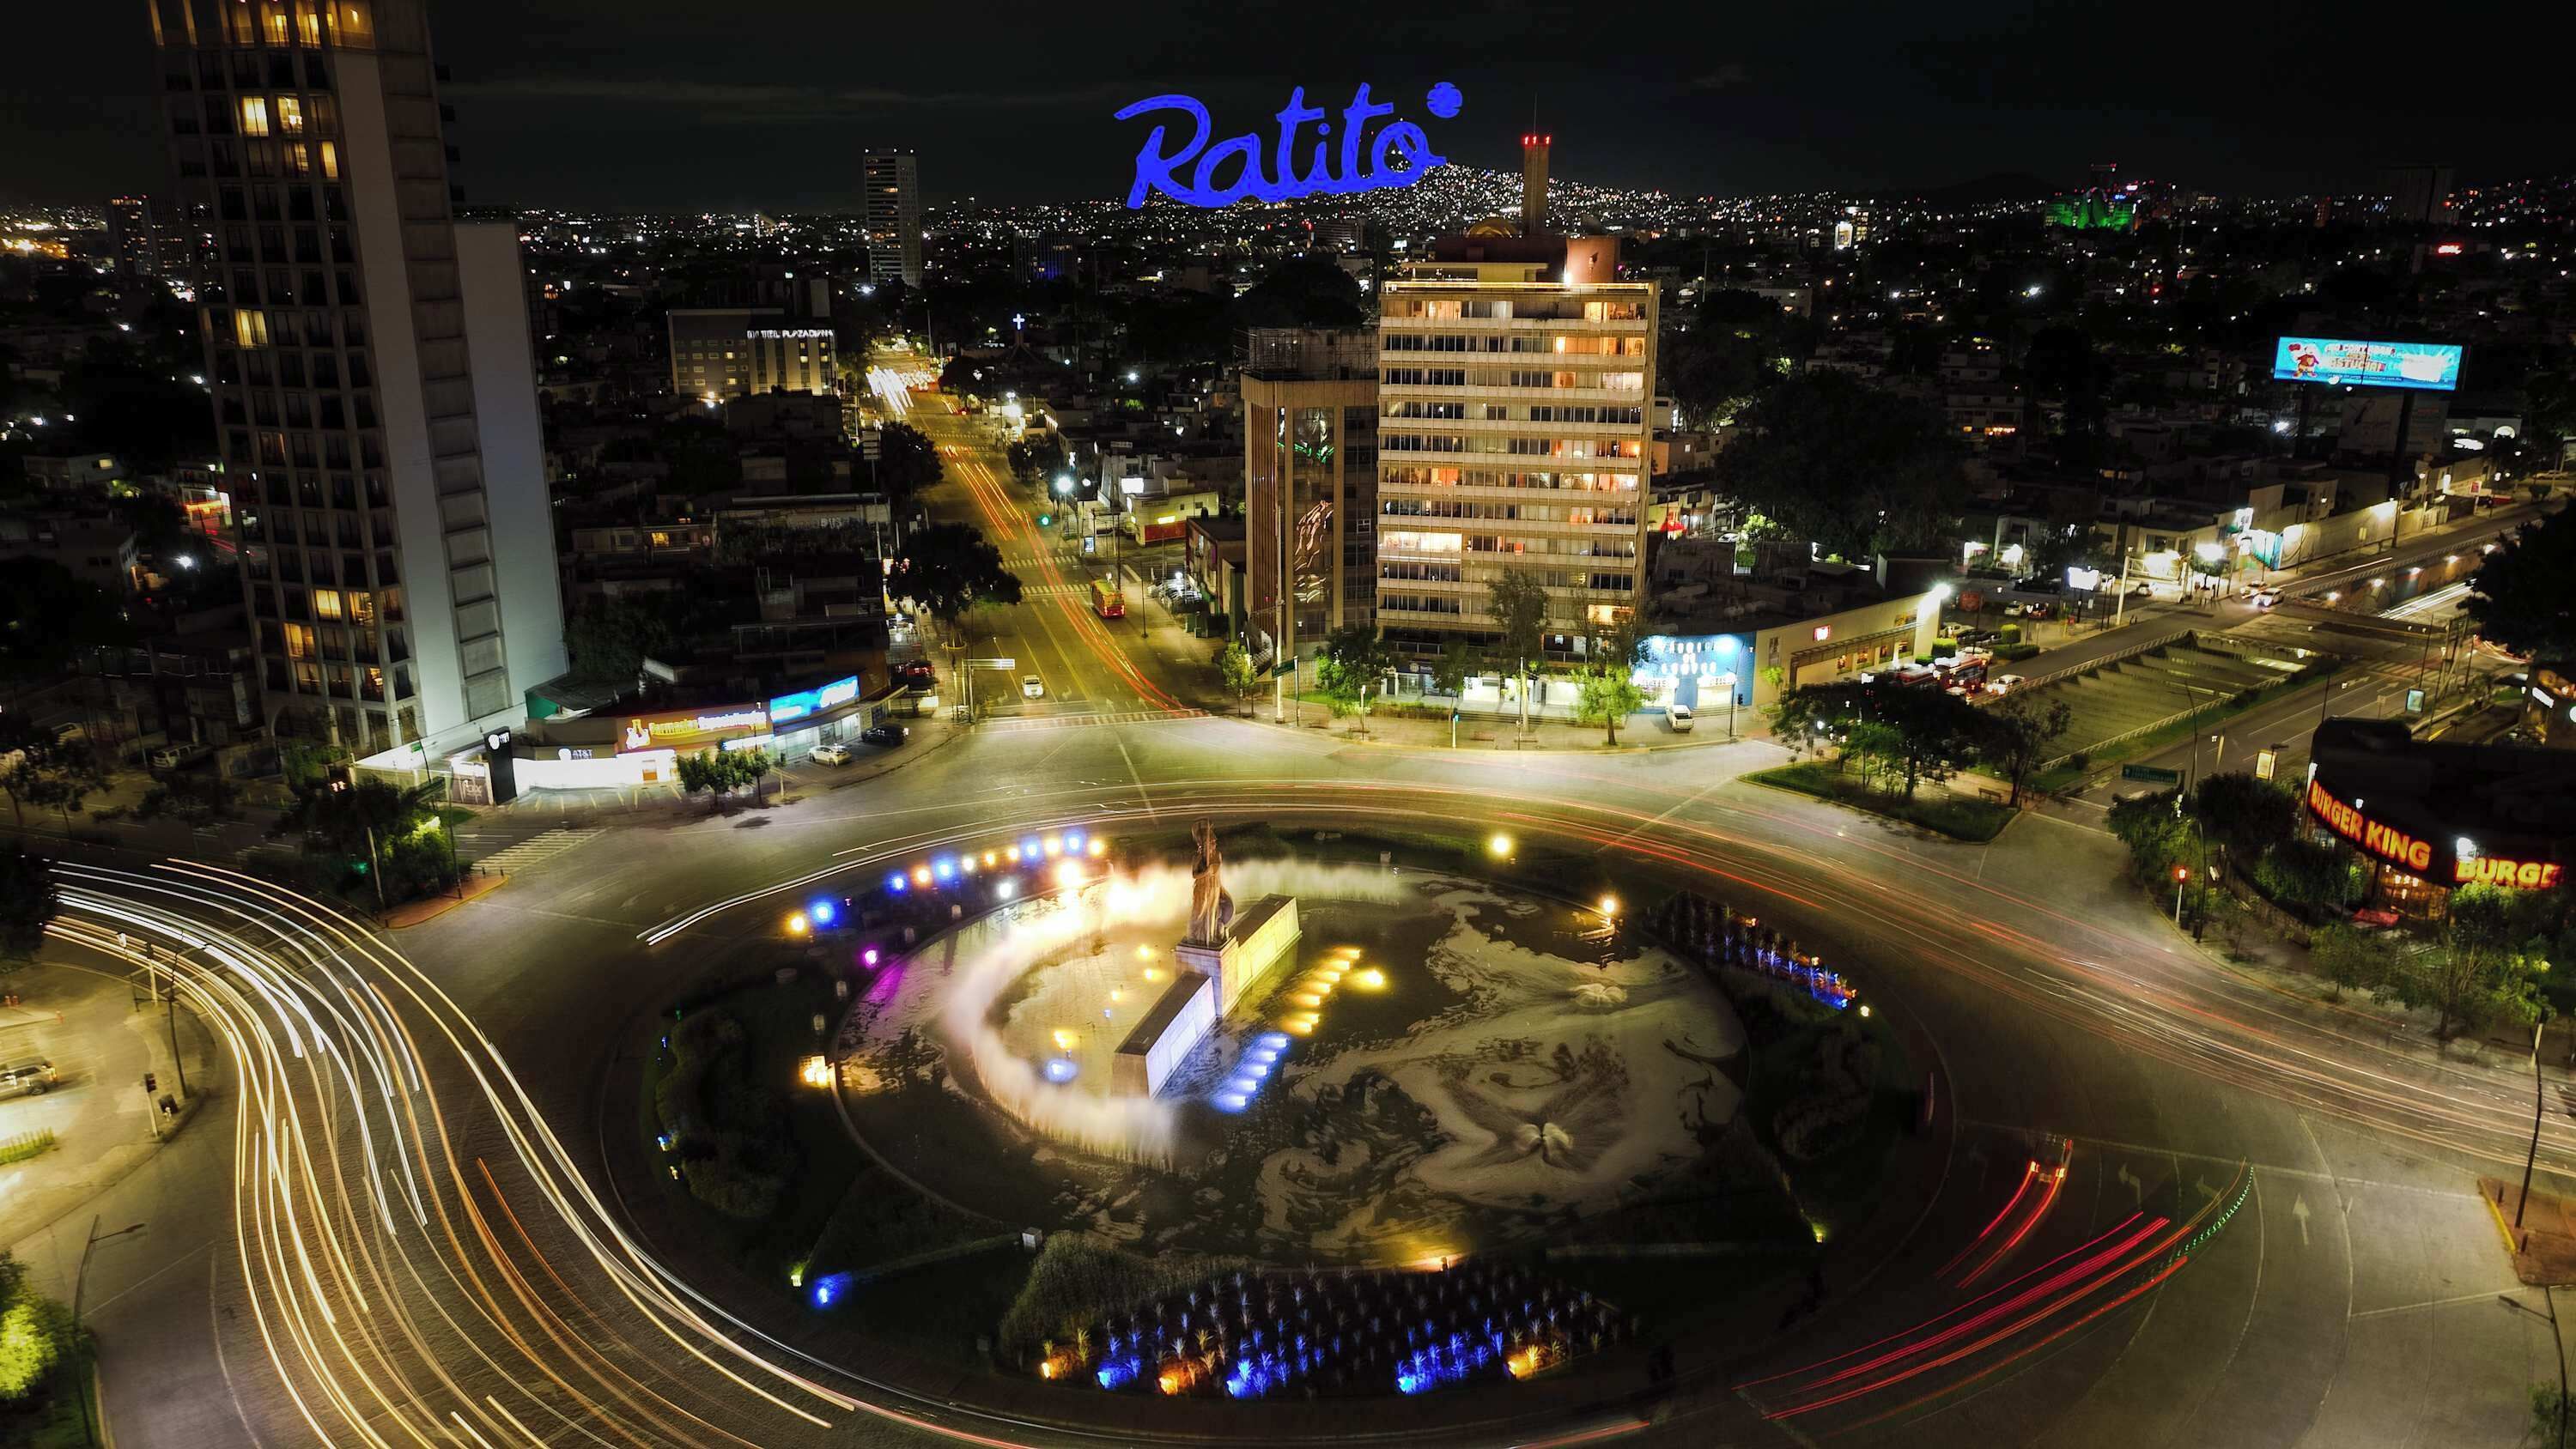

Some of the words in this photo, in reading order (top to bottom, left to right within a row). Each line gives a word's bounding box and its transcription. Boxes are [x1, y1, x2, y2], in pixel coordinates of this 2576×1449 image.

[571, 749, 592, 760] AT&T
[2310, 779, 2362, 840] BURGER
[2366, 820, 2432, 870] KING
